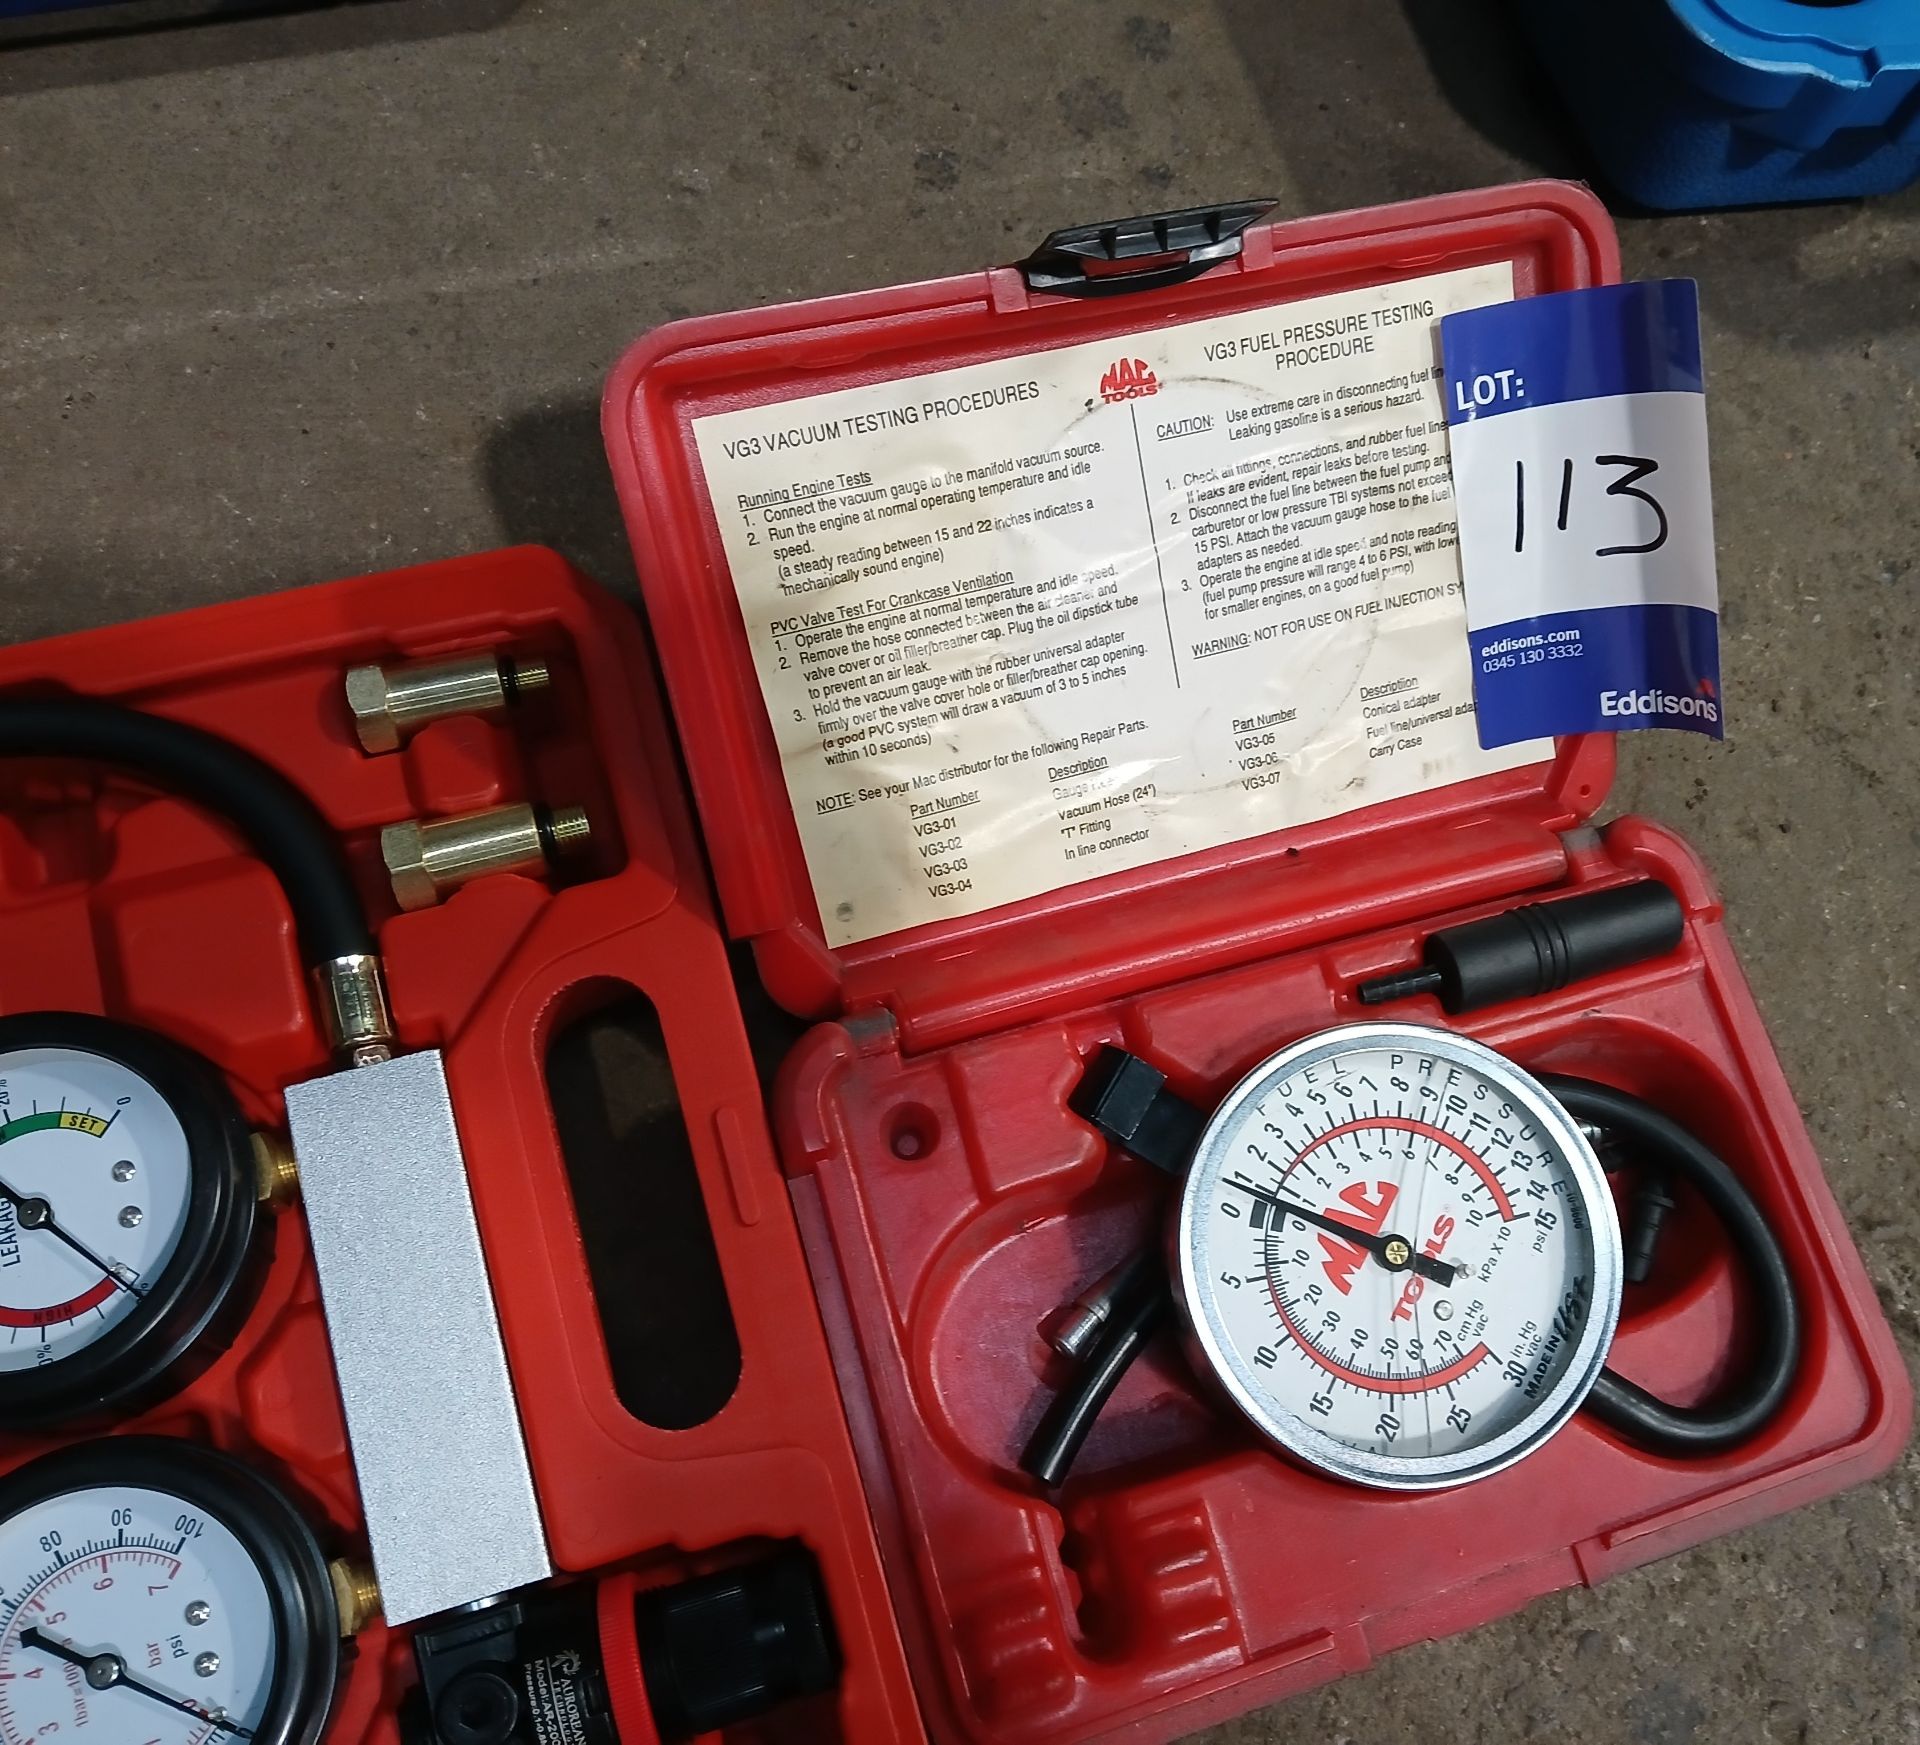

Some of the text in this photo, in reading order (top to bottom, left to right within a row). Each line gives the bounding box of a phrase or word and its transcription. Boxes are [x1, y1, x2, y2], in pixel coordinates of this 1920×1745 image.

[1203, 299, 1434, 362] VG3 FUEL PRESSURE TESTING
[1275, 334, 1376, 371] PROCEDURE
[1100, 358, 1157, 394] MAC
[1101, 385, 1158, 404] TOOLS
[1456, 369, 1526, 411] LOT:
[722, 381, 1040, 460] VG3 VACUUM TESTING PROCEDURES
[1228, 387, 1425, 441] Leaking gasoline is a serious hazard.
[1155, 414, 1215, 439] CAUTION:
[736, 471, 872, 510] Running Engine Tests
[1514, 454, 1669, 557] 113
[769, 570, 1015, 635] PVC Valve Test For Crankcase Ventilation
[1190, 579, 1465, 657] WARNING: NOT FOR USE ON FUEL INJECTION SY
[1481, 628, 1581, 658] eddisons.com
[1482, 643, 1584, 674] 0345 130 3332
[1362, 692, 1442, 720] Conical adapter
[1600, 689, 1718, 723] Eddisons
[1231, 707, 1298, 734] Part Number
[1234, 731, 1276, 752] VG3-05
[1368, 736, 1423, 759] Carry Case
[815, 720, 1149, 816] NOTE: See your Mac distributor for the following Repair Parts.
[1047, 756, 1110, 780] Description
[1240, 770, 1281, 792] VG3-07
[908, 789, 979, 817] Part Number
[1056, 801, 1103, 821] Vacuum
[1102, 788, 1131, 809] Hose
[911, 816, 958, 838] VG3-01
[1076, 816, 1112, 836] Fitting
[917, 835, 964, 859] VG3-02
[1063, 828, 1150, 861] In line connector
[922, 857, 969, 879] VG3-03
[927, 877, 973, 898] VG3-04
[1333, 1082, 1353, 1098] 6
[1359, 1076, 1378, 1092] 7
[1390, 1076, 1410, 1092] 8
[1419, 1086, 1439, 1102] 9
[116, 1096, 131, 1105] 0
[1306, 1089, 1327, 1105] 5
[1445, 1095, 1468, 1117] 10
[1285, 1102, 1304, 1118] 4
[69, 1115, 98, 1130] SET
[1264, 1123, 1284, 1139] 3
[1391, 1054, 1568, 1196] PRESSURE
[1469, 1112, 1492, 1132] 11
[1491, 1127, 1515, 1150] 12
[1247, 1144, 1268, 1161] 2
[1358, 1151, 1373, 1162] 4
[1378, 1147, 1393, 1160] 5
[1401, 1149, 1416, 1160] 6
[1425, 1156, 1439, 1171] 7
[1510, 1150, 1533, 1172] 13
[1234, 1170, 1253, 1183] 1
[1336, 1162, 1351, 1174] 3
[1444, 1173, 1459, 1185] 8
[1316, 1176, 1332, 1190] 2
[1526, 1179, 1549, 1201] 14
[1302, 1199, 1317, 1208] 1
[1461, 1193, 1476, 1203] 9
[1220, 1202, 1241, 1219] 0
[1465, 1209, 1484, 1228] 10
[1534, 1208, 1558, 1231] 15
[1292, 1220, 1307, 1232] 0
[1317, 1181, 1399, 1296] MAC
[1532, 1229, 1548, 1253] psi
[1292, 1249, 1310, 1267] 10
[1477, 1257, 1498, 1283] kPa
[1497, 1226, 1511, 1241] 10
[1391, 1214, 1455, 1322] TOLS
[1220, 1271, 1242, 1289] 5
[1303, 1283, 1323, 1306] 20
[1321, 1310, 1341, 1332] 30
[1457, 1299, 1485, 1342] cm Hg
[1471, 1313, 1489, 1338] vac
[1350, 1328, 1369, 1350] 40
[1380, 1337, 1399, 1360] 50
[1406, 1338, 1424, 1361] 60
[1432, 1329, 1453, 1352] 70
[1511, 1320, 1538, 1358] in. Hg
[1525, 1334, 1543, 1357] vac
[1253, 1345, 1278, 1370] 10
[1523, 1334, 1561, 1399] MADE IN
[1502, 1359, 1528, 1388] 30
[1309, 1391, 1334, 1417] 15
[1375, 1413, 1401, 1443] 20
[1446, 1404, 1472, 1434] 25
[111, 1508, 132, 1526] 90
[174, 1514, 204, 1538] 100
[39, 1530, 62, 1552] 80
[93, 1577, 114, 1590] 6
[148, 1584, 168, 1596] 7
[46, 1611, 66, 1625] 5
[147, 1642, 162, 1668] bar
[166, 1634, 189, 1659] psi
[24, 1667, 44, 1680] 4
[38, 1721, 59, 1736] 3
